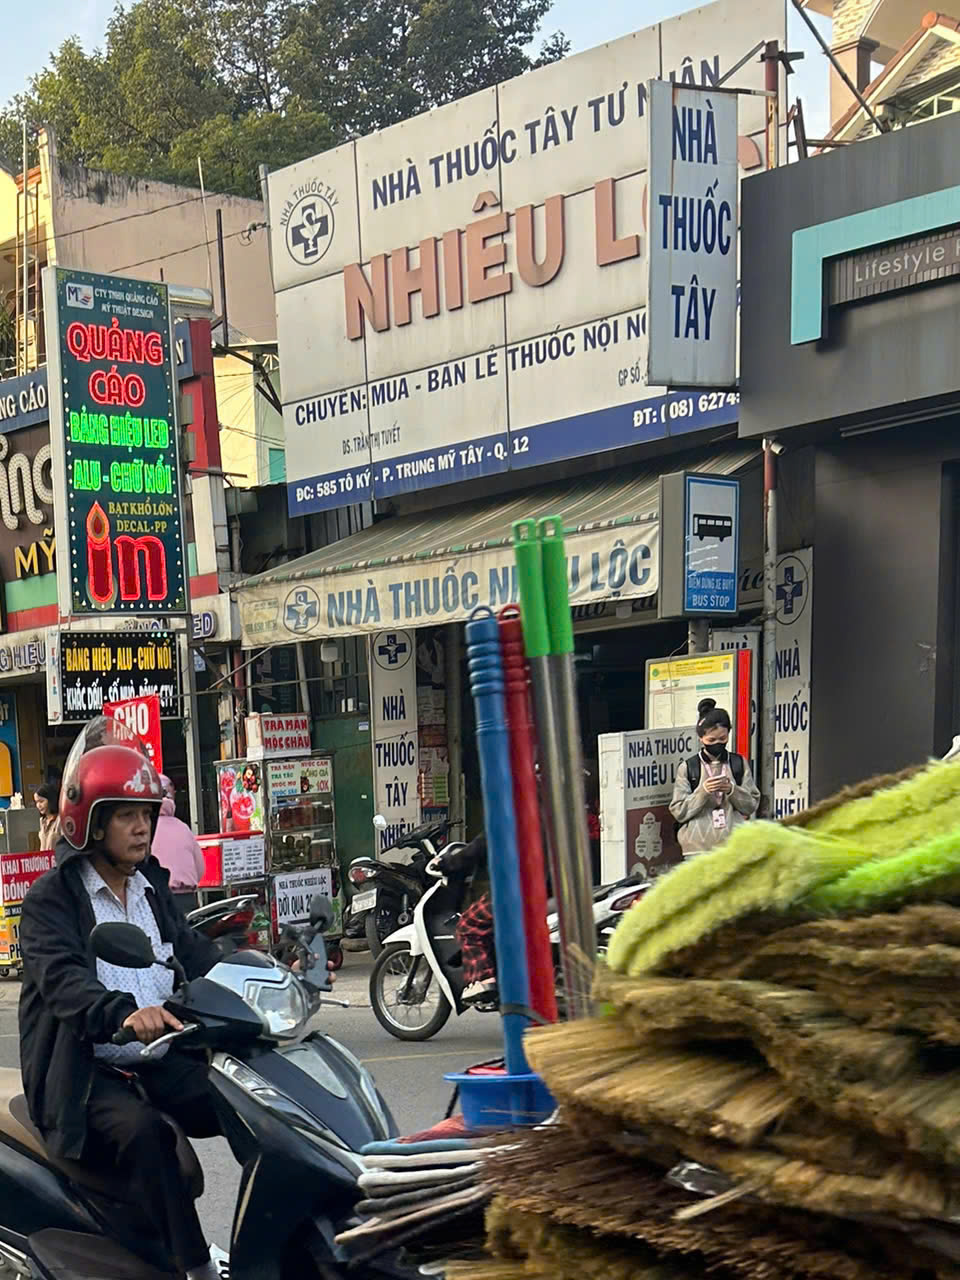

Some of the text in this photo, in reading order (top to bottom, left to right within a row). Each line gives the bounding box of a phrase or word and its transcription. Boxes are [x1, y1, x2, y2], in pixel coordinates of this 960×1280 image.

[372, 81, 629, 210] NHÀ THUỐC TÂY TƯ
[672, 99, 718, 165] NHÀ
[658, 178, 732, 256] THUỐC
[343, 191, 565, 341] NHIÊU
[855, 246, 945, 283] Lifestyle
[145, 295, 159, 306] CÁO
[671, 274, 716, 341] TÂY
[66, 317, 164, 366] QUẢNG
[372, 377, 409, 407] MUA
[508, 325, 575, 371] THUỐC
[584, 318, 618, 352] NỘI
[19, 382, 46, 413] CÁO
[89, 365, 145, 407] CÁO
[70, 405, 170, 453] BẢNG HIỆU LED
[633, 408, 657, 427] ĐT:
[74, 454, 172, 494] ALU CHỮ NỔI
[296, 487, 314, 502] ĐC:
[317, 480, 337, 497] 585
[356, 469, 371, 487] KÝ
[396, 458, 435, 480] TRUNG
[438, 450, 456, 470] MỸ
[460, 445, 484, 465] TÂY
[494, 442, 508, 460] Q.
[513, 436, 529, 454] 12
[108, 501, 128, 518] BẠT
[129, 497, 152, 515] KHỔ
[14, 528, 57, 578] MỸ
[86, 500, 168, 603] in
[591, 539, 652, 597] LỘC
[327, 579, 381, 629] NHÀ
[389, 560, 479, 621] THUỐC
[692, 595, 730, 608] BUS STOP
[66, 639, 172, 677] BẢNG HIỆU ALU CHỮ NỔI
[67, 677, 86, 710] KHẮC
[87, 678, 103, 710] DẤU
[160, 685, 173, 707] CTY
[382, 689, 406, 721] NHÀ
[775, 690, 808, 733] HUỐC
[376, 734, 415, 768] THUỐC
[628, 732, 693, 759] NHÀ THUỐC
[774, 743, 800, 780] TÂY
[385, 778, 408, 808] TÂY
[627, 764, 668, 789] NHIÊU
[2, 858, 19, 876] KHAI
[291, 896, 305, 918] QUA
